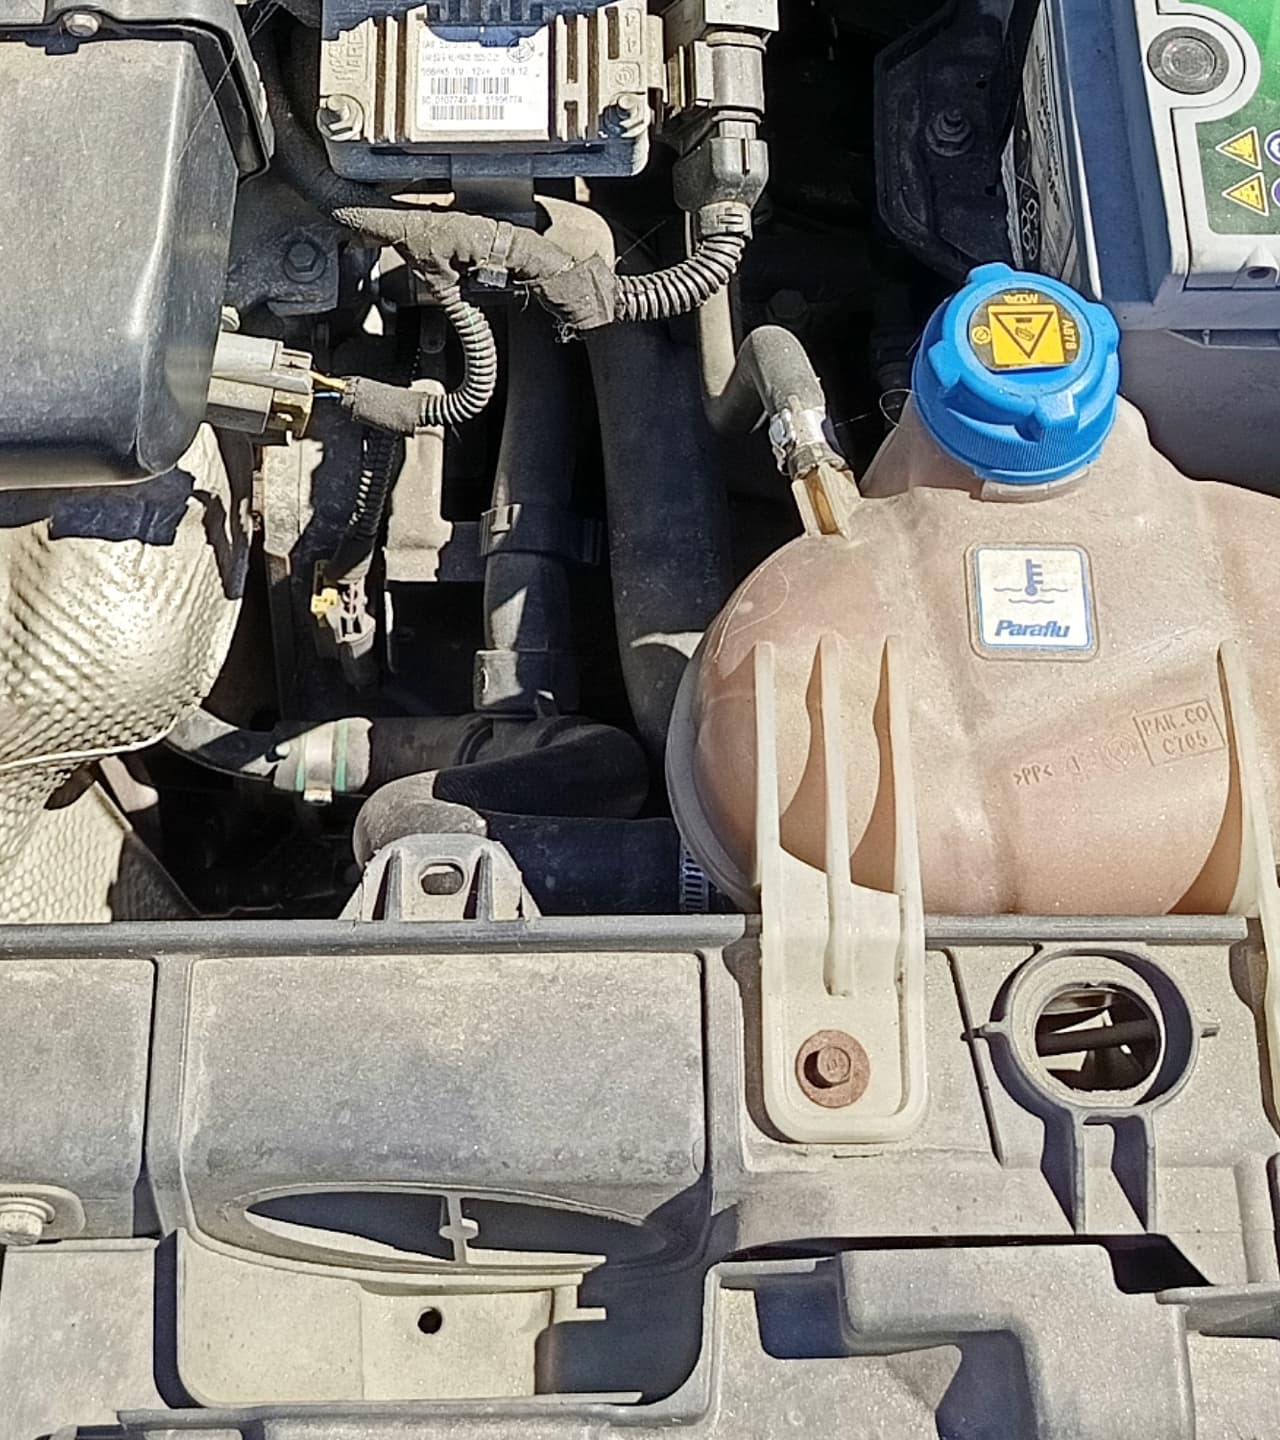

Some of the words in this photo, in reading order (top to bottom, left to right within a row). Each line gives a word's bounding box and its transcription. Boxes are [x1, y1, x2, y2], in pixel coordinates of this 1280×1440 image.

[994, 620, 1070, 638] Paraflu
[1141, 705, 1208, 736] PAR.CO
[1162, 730, 1208, 756] C705
